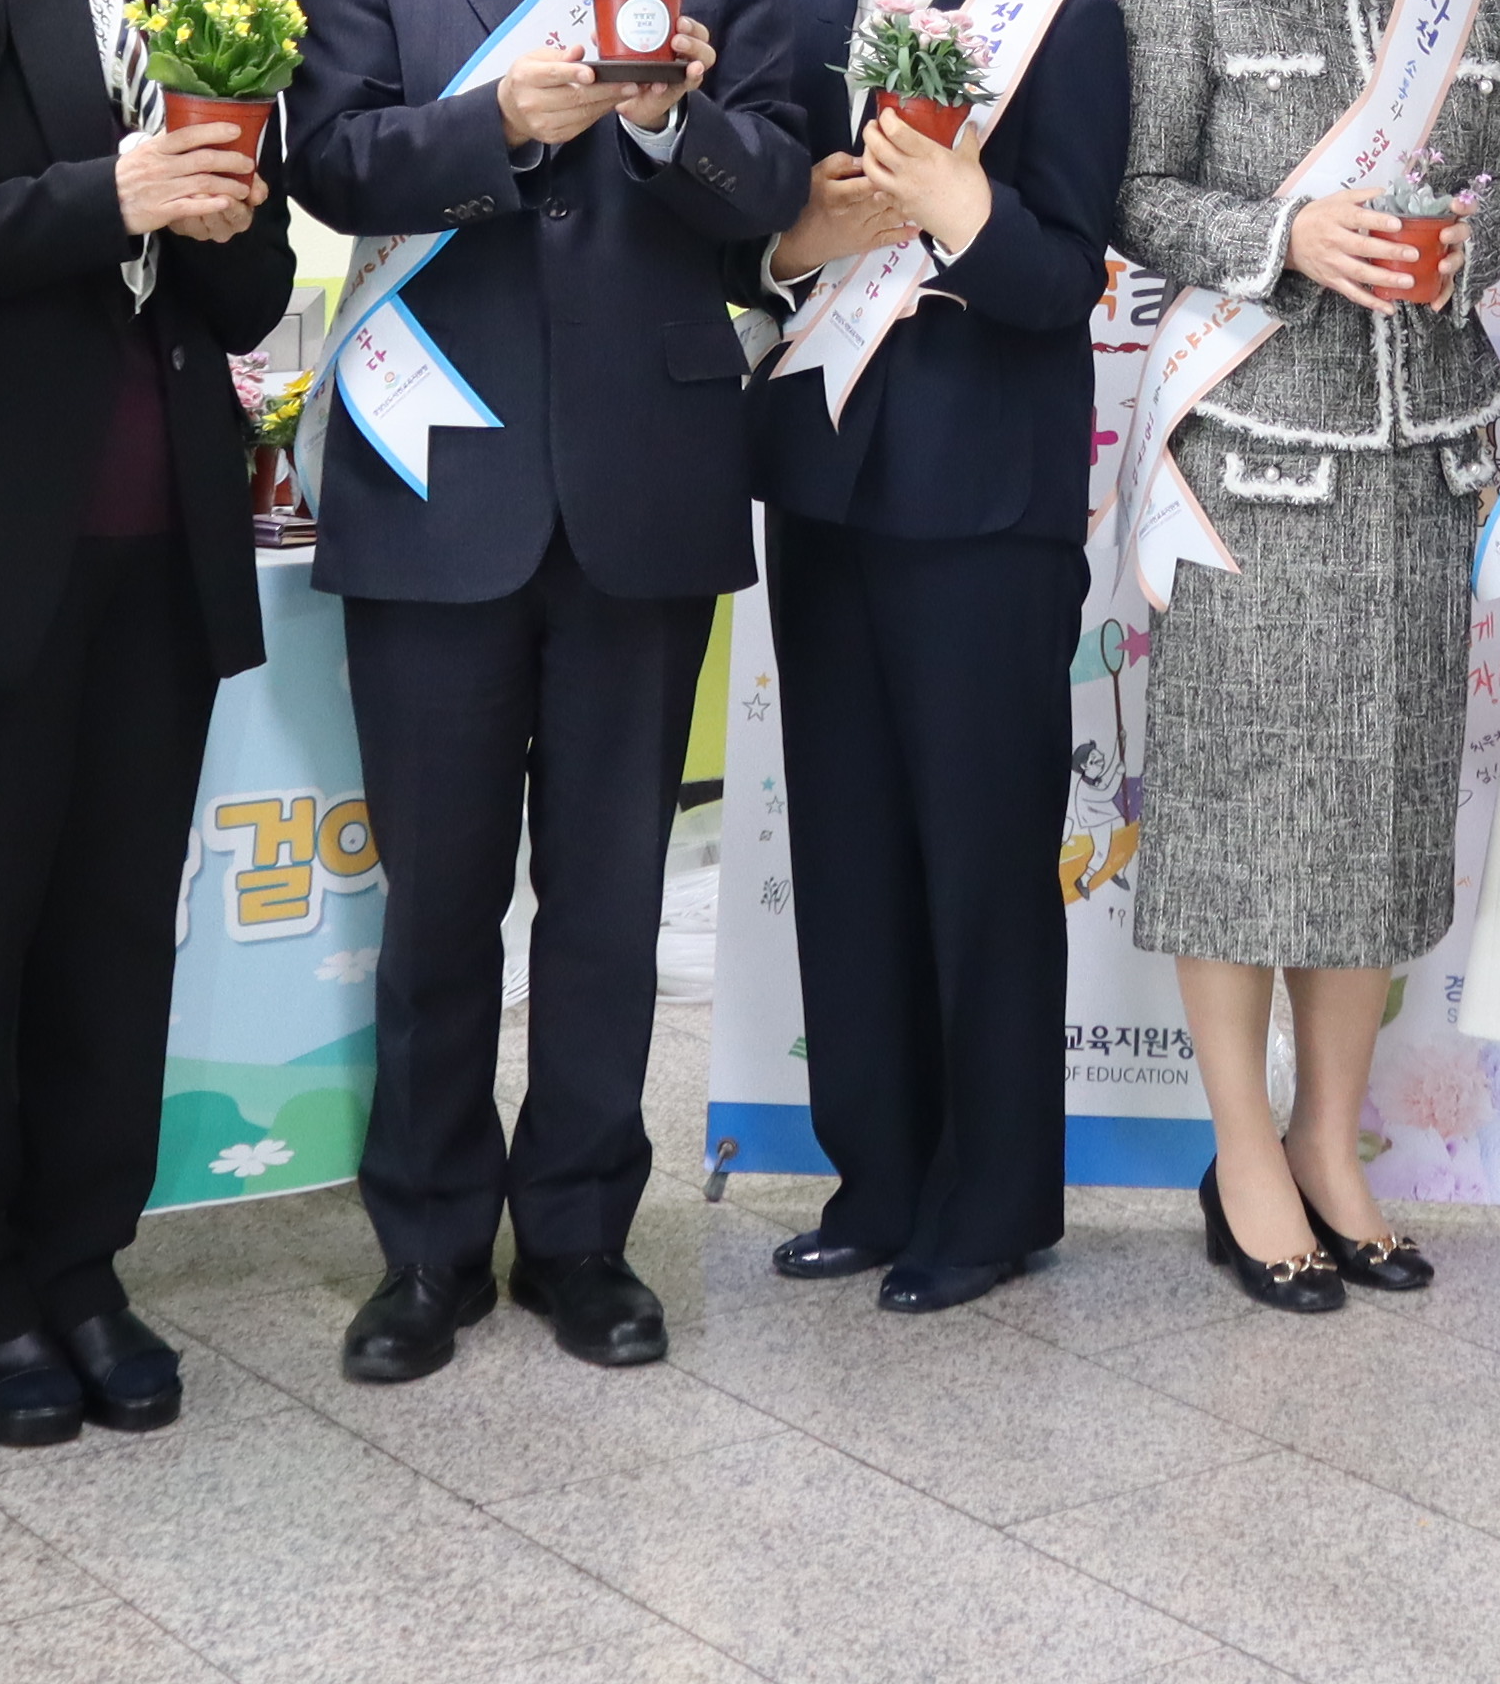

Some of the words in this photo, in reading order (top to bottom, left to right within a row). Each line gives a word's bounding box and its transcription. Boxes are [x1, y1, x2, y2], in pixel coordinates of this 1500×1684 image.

[1340, 128, 1391, 190] 협력으
[865, 241, 910, 301] 꾸다
[355, 327, 388, 372] 꾸다
[1086, 1066, 1189, 1085] EDUCATION
